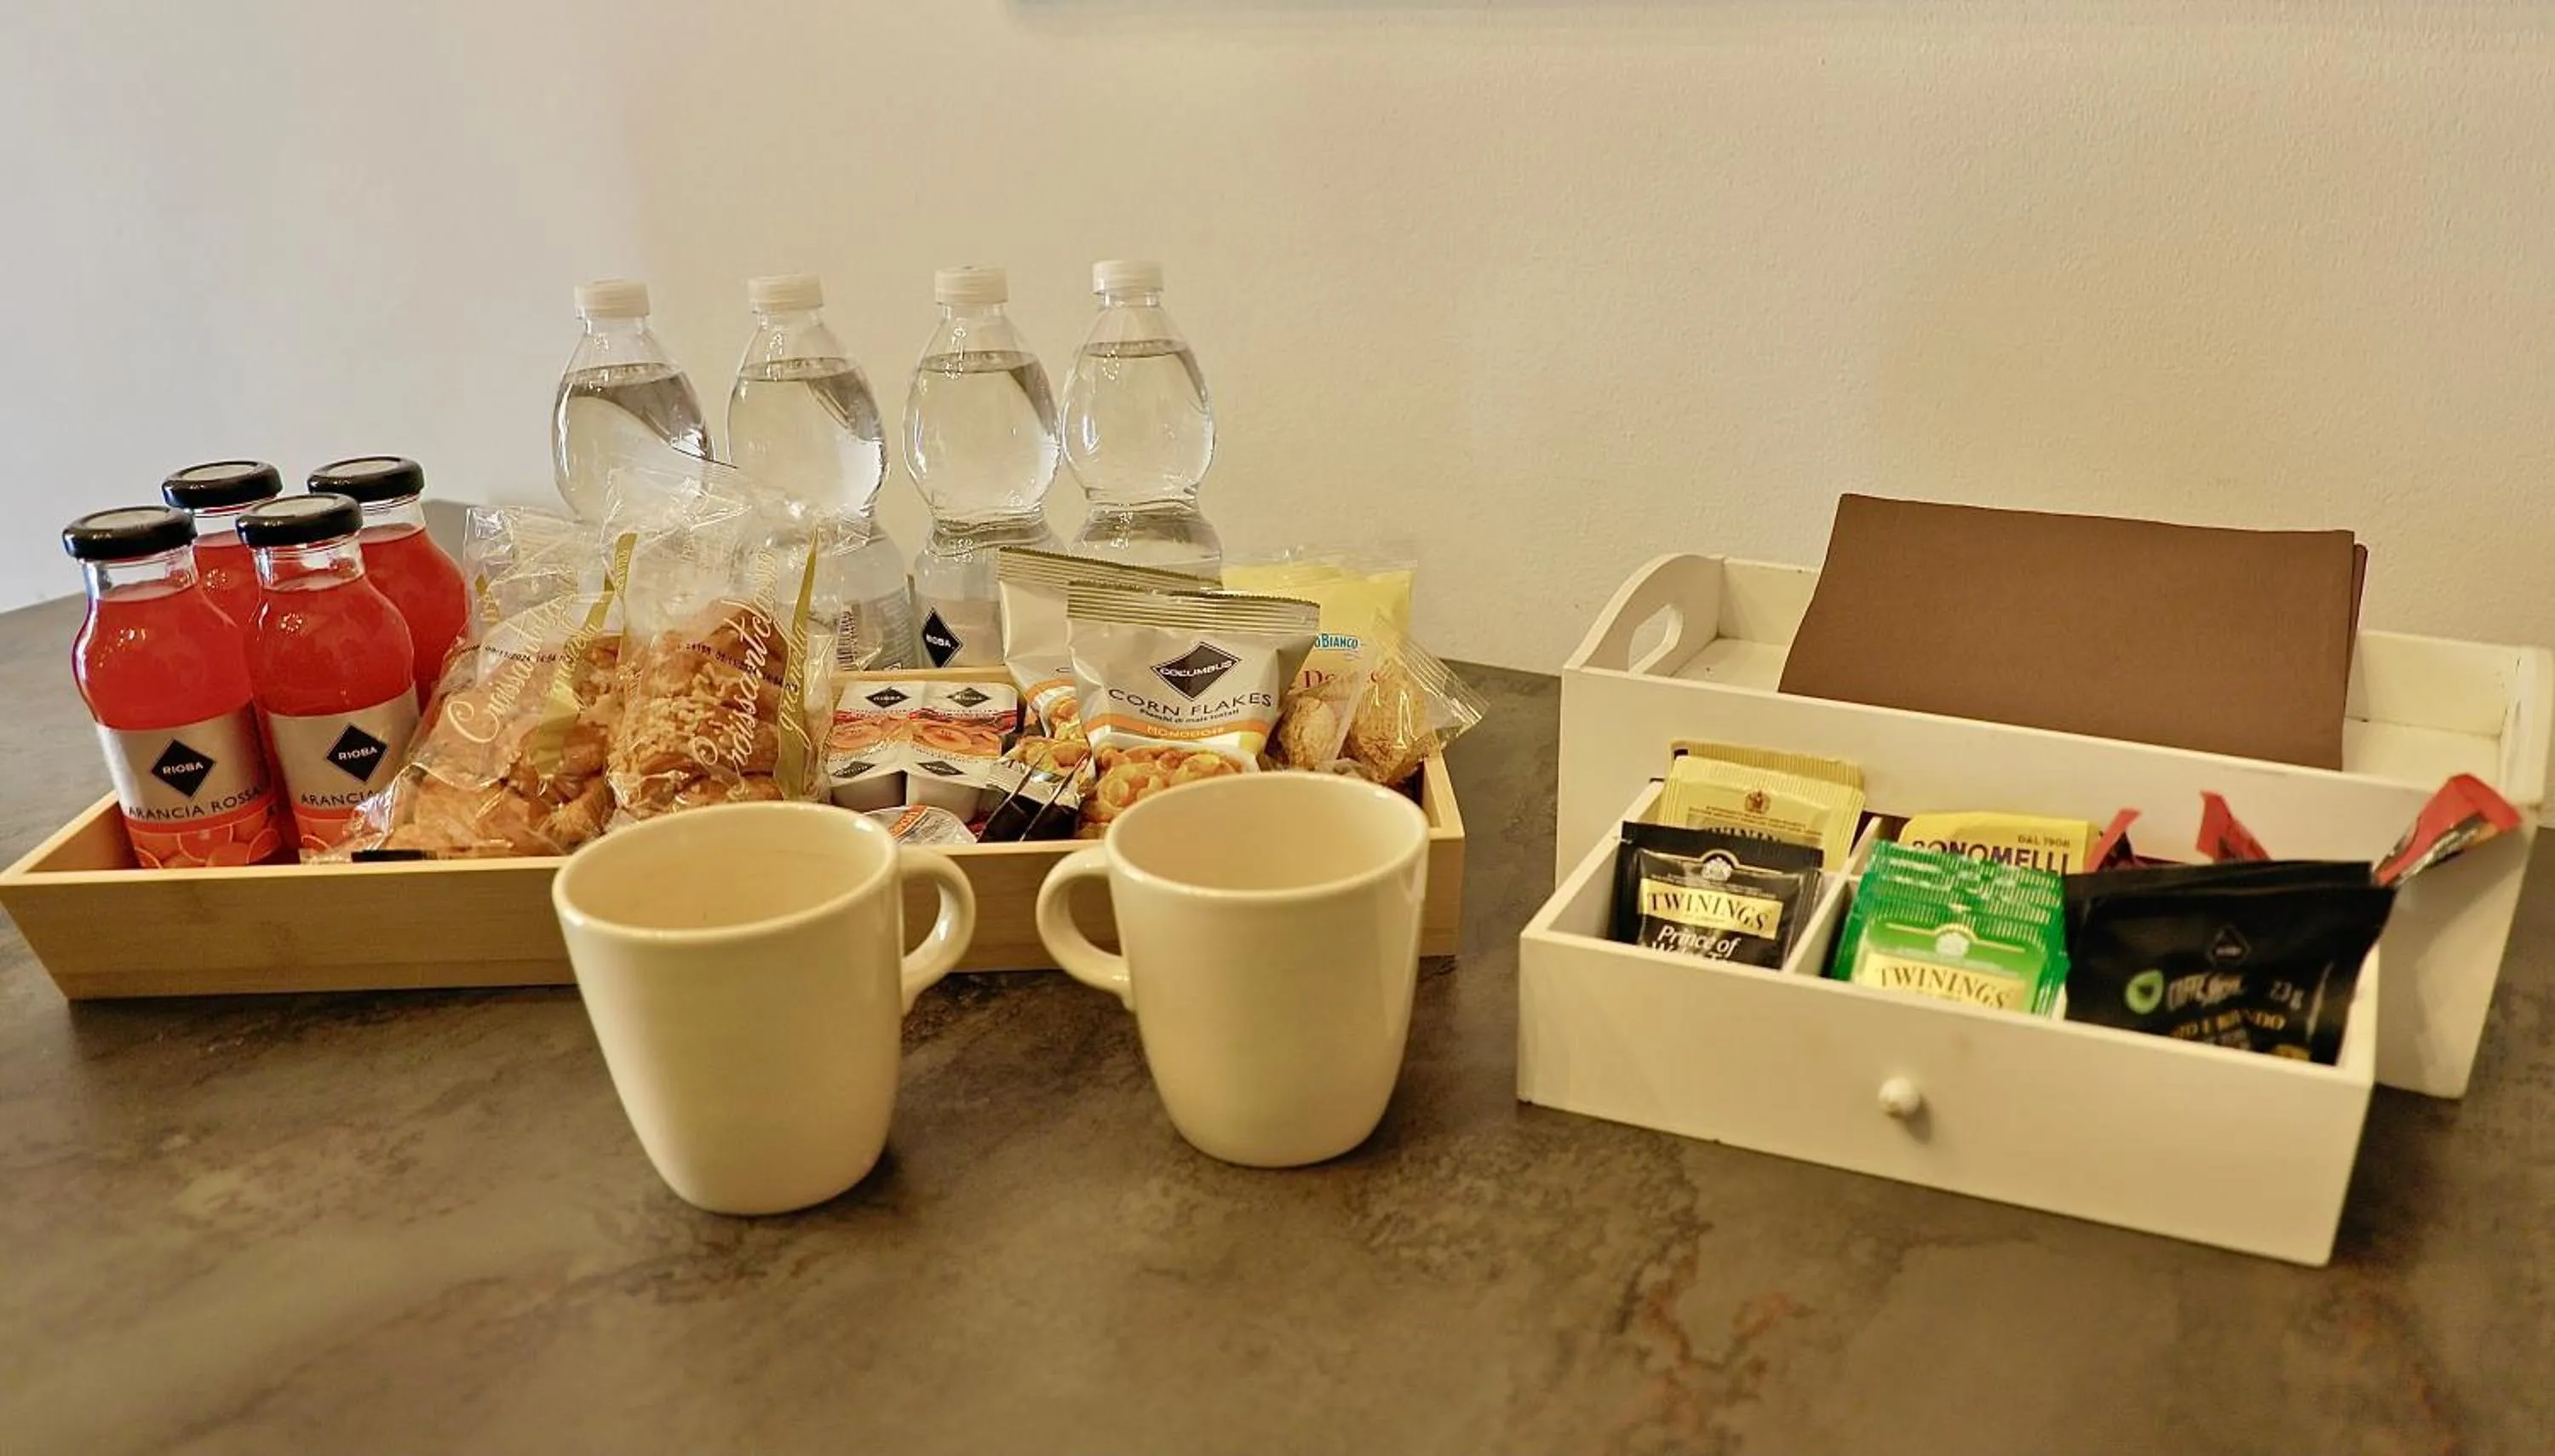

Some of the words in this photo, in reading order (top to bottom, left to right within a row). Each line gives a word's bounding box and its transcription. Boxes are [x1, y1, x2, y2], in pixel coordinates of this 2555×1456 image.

[1159, 659, 1233, 677] COLUMBUS
[1108, 689, 1180, 716] CORN
[1191, 692, 1272, 715] FLAKES
[338, 745, 378, 760] RIOBA
[162, 760, 204, 775] RIOBA
[129, 805, 205, 820] ARANCIA
[1646, 891, 1770, 931] TWININGS
[1657, 924, 1716, 951] Prince
[1715, 936, 1742, 958] of
[1875, 966, 2009, 1009] TWININGS
